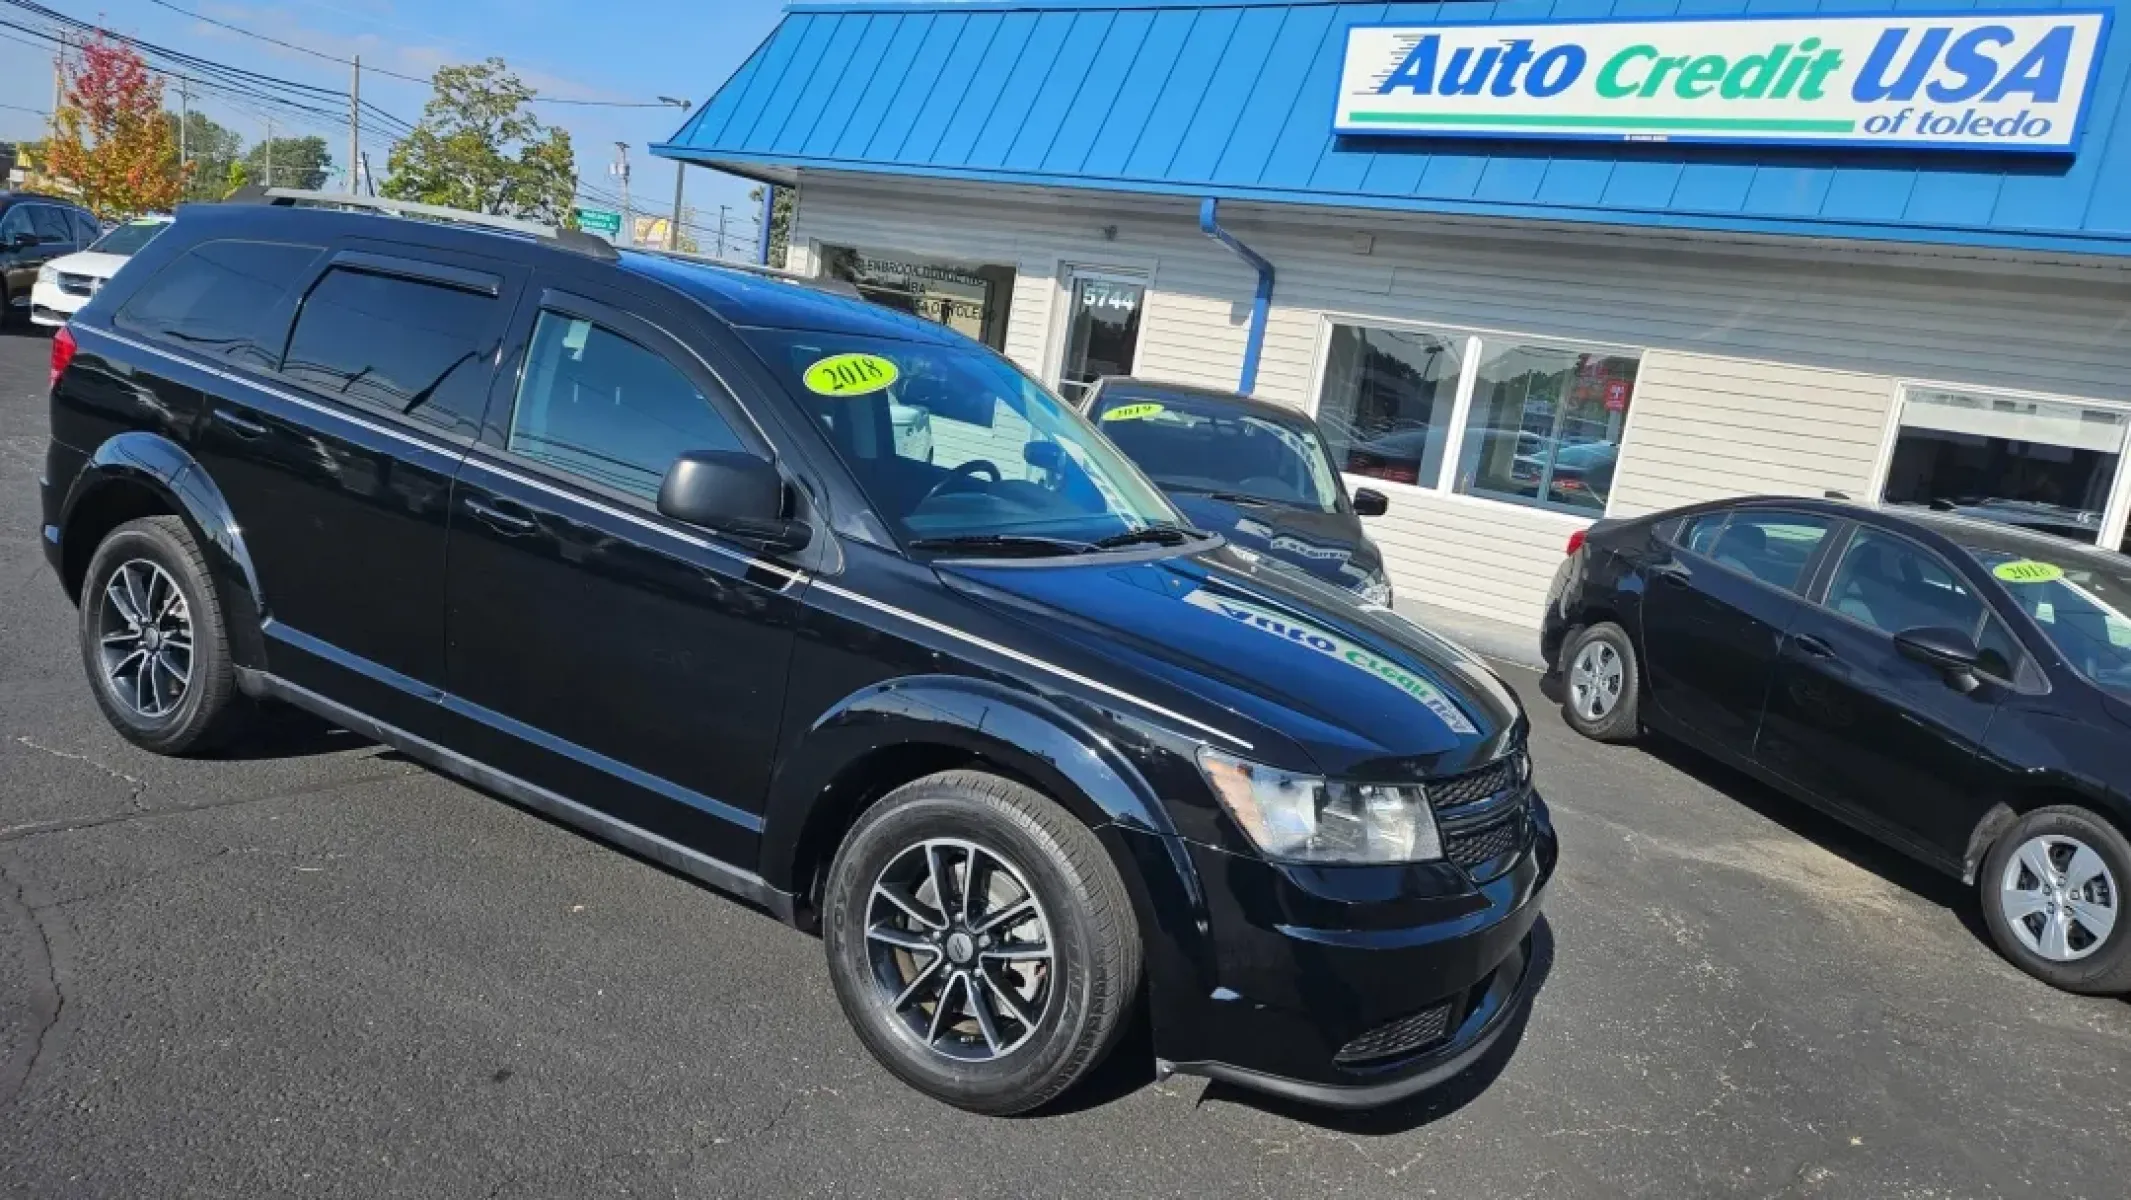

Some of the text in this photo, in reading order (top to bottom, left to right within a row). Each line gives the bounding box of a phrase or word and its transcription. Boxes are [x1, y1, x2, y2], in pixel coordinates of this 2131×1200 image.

[1376, 25, 2076, 103] Auto Credit USA
[1863, 108, 2052, 137] of toledo
[1083, 287, 1135, 310] 5744
[822, 358, 883, 391] 2018
